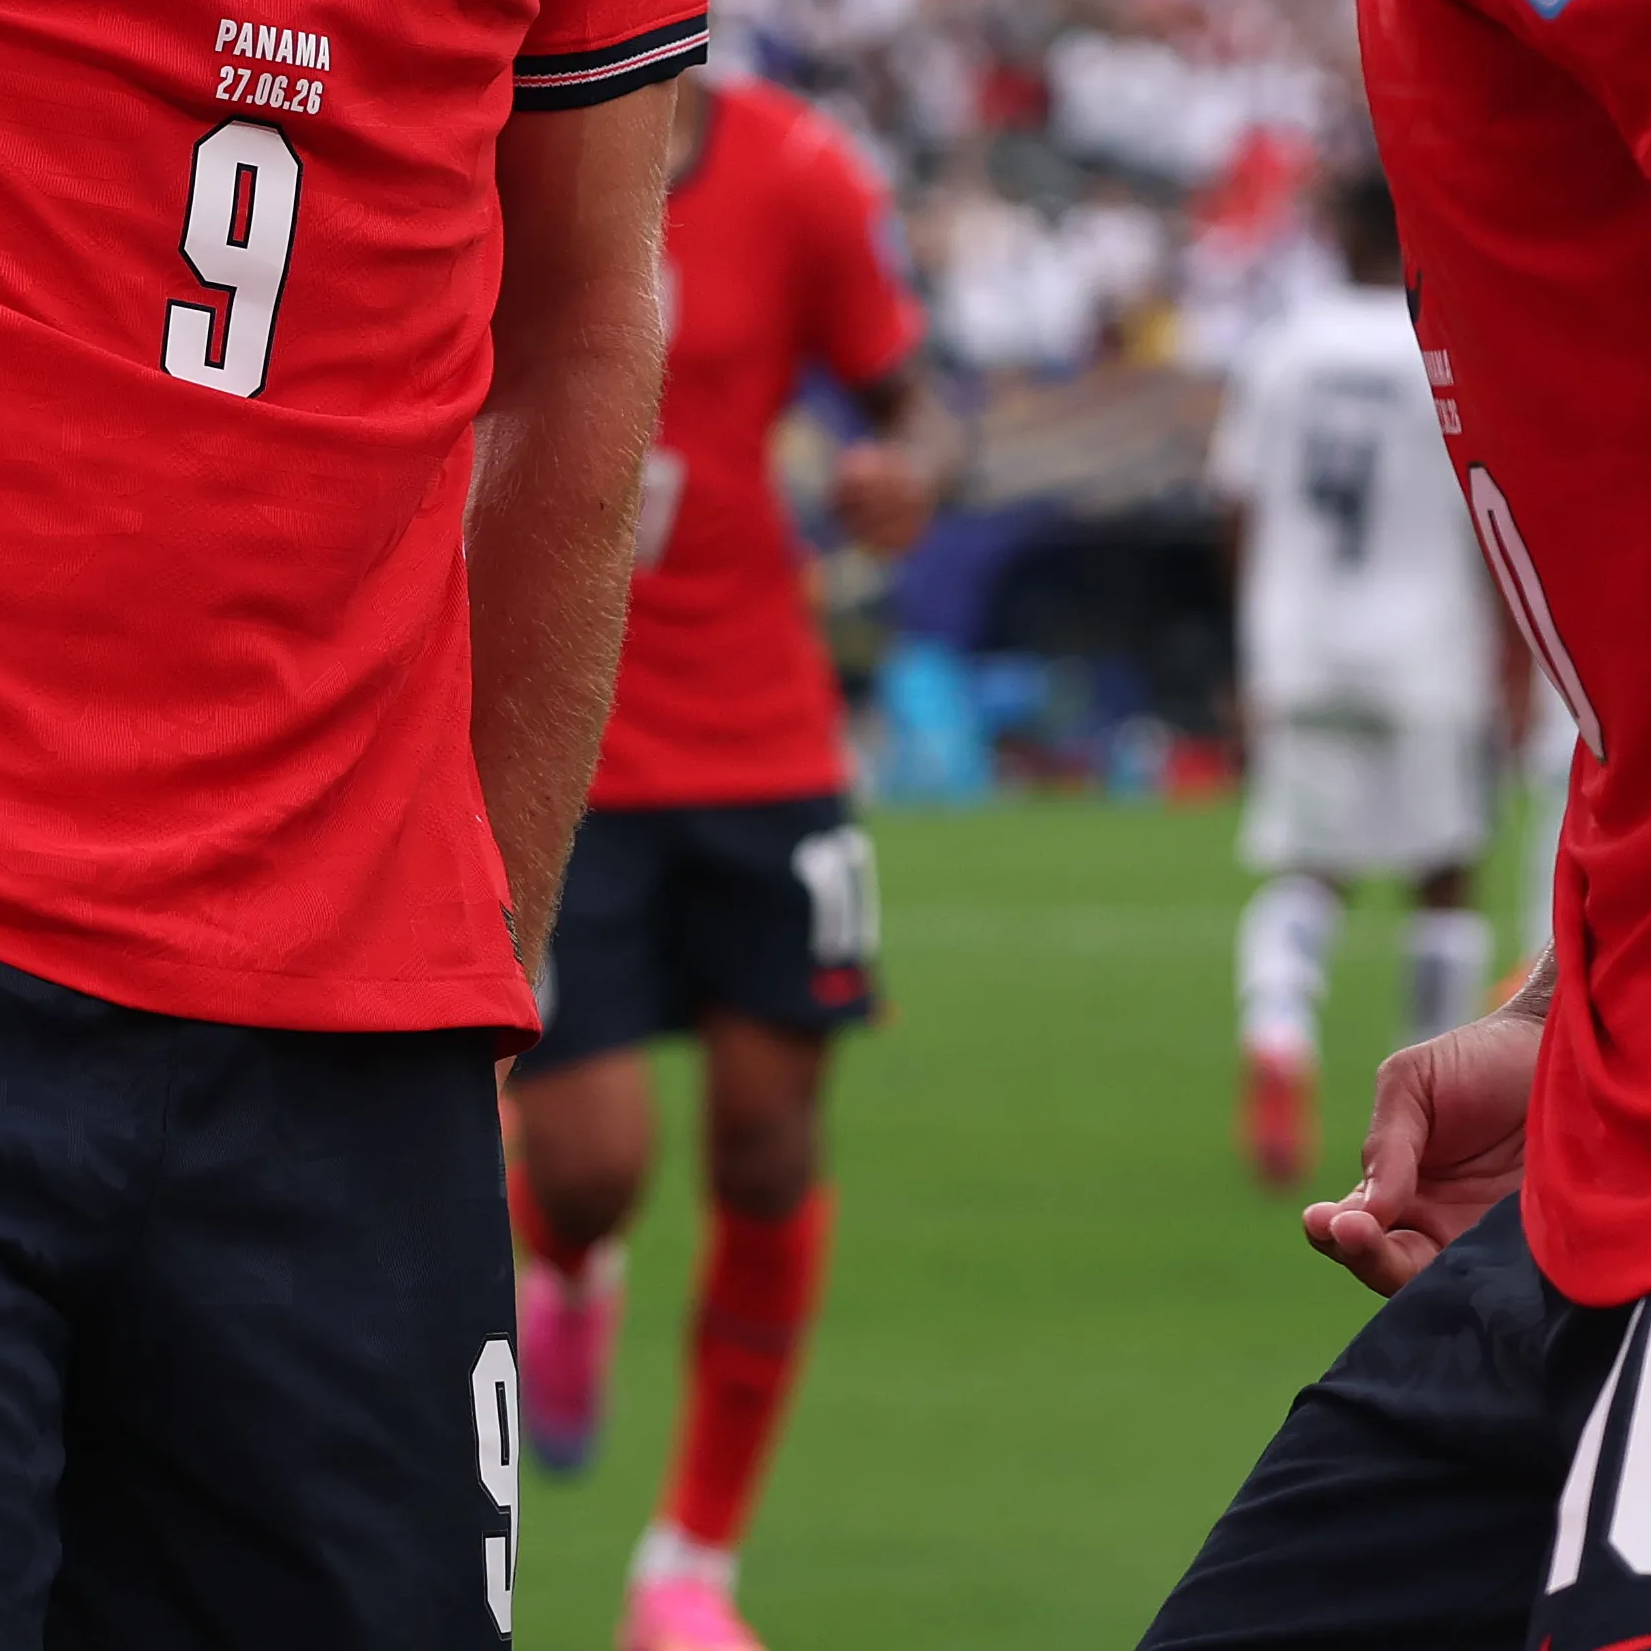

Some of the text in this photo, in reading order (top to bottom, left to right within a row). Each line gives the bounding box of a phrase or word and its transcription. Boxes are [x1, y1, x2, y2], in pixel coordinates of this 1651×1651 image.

[215, 17, 332, 72] PANAMA
[216, 65, 322, 115] 27.06.26
[160, 115, 303, 399] 9
[470, 1333, 519, 1641] 9
